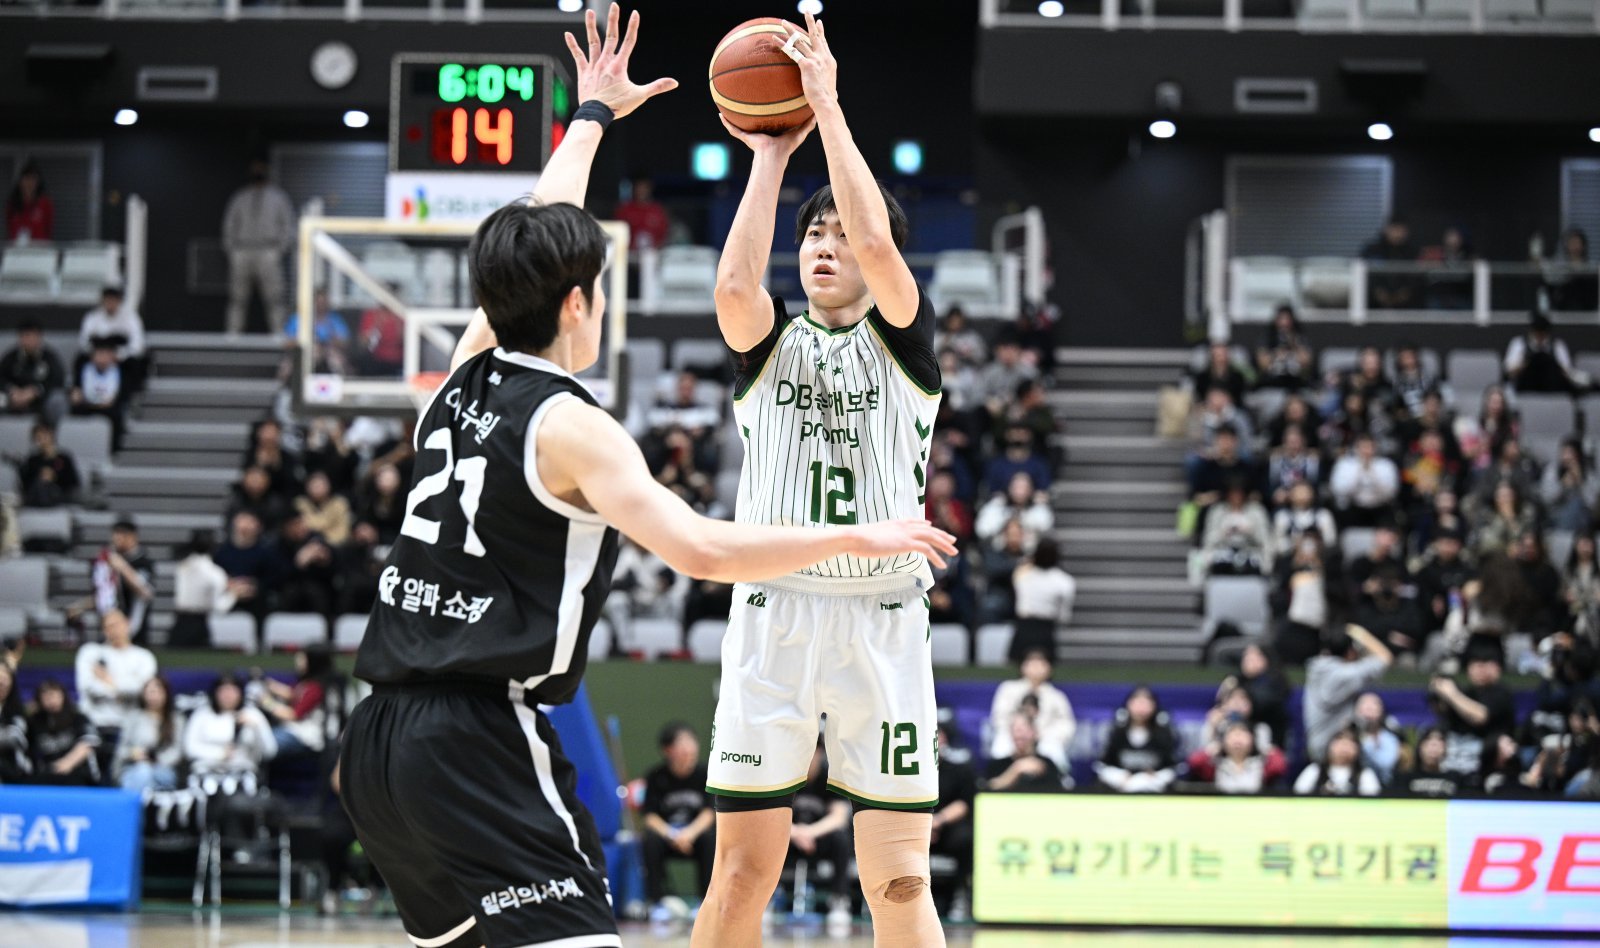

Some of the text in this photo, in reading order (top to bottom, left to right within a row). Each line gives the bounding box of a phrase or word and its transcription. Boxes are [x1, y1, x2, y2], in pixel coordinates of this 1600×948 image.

[438, 63, 534, 103] 6:04
[451, 107, 514, 165] 14
[800, 421, 860, 448] promy
[400, 427, 488, 558] 21
[810, 460, 857, 526] 12
[401, 578, 441, 617] 알파
[441, 590, 494, 624] 쇼핑
[720, 751, 762, 767] promy
[880, 721, 920, 776] 12
[0, 813, 92, 853] EAT
